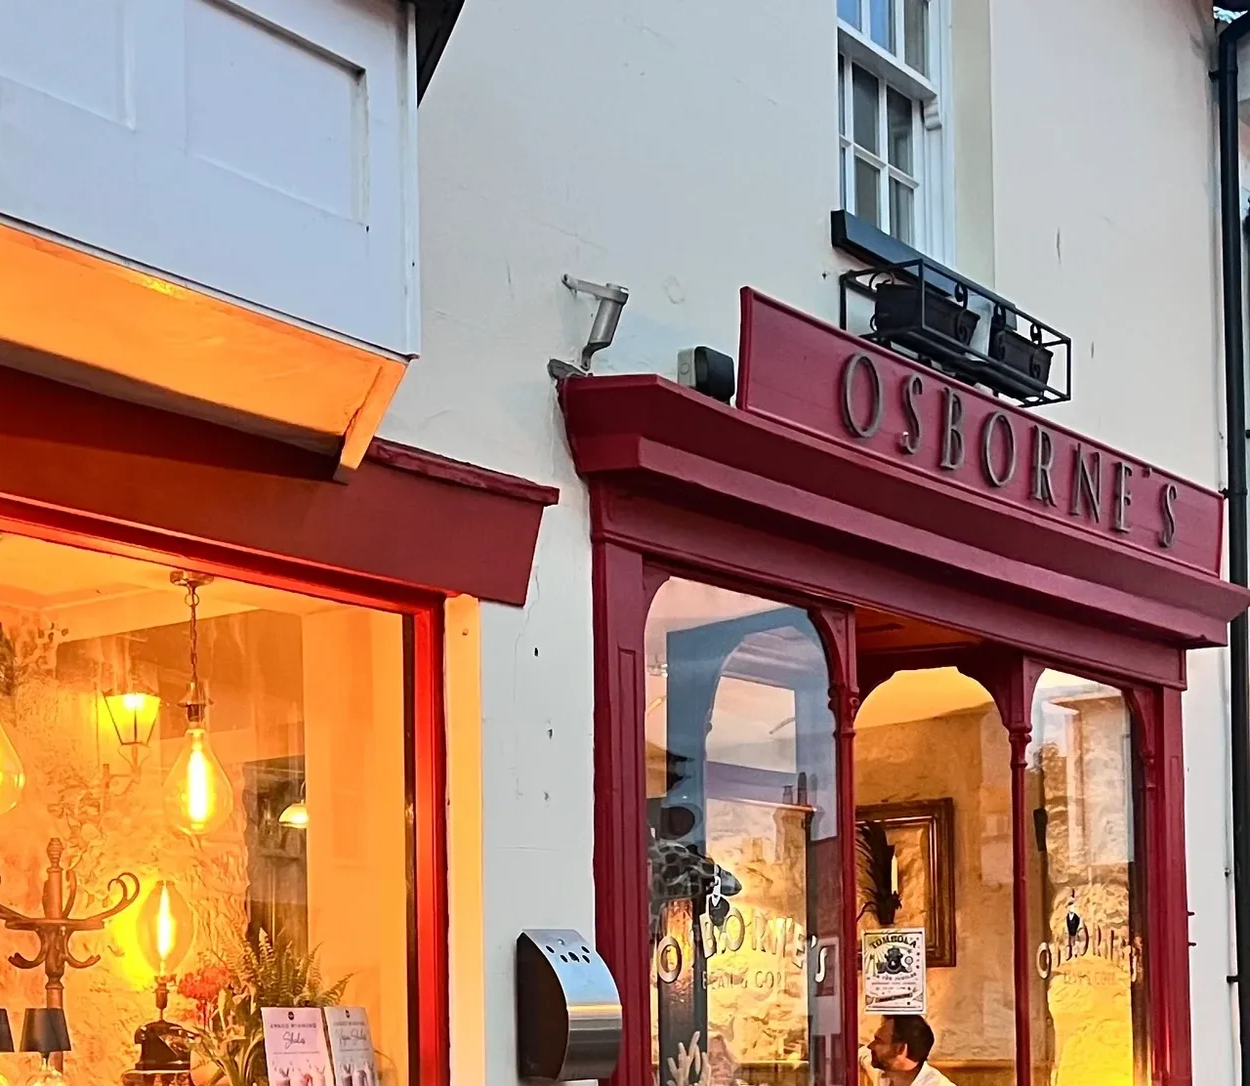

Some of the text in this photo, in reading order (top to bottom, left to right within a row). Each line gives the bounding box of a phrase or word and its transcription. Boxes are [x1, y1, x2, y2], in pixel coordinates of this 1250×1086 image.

[842, 353, 1177, 548] OSBORNE'S
[657, 906, 828, 983] OBORNE'S
[870, 934, 917, 949] TOMBOLA
